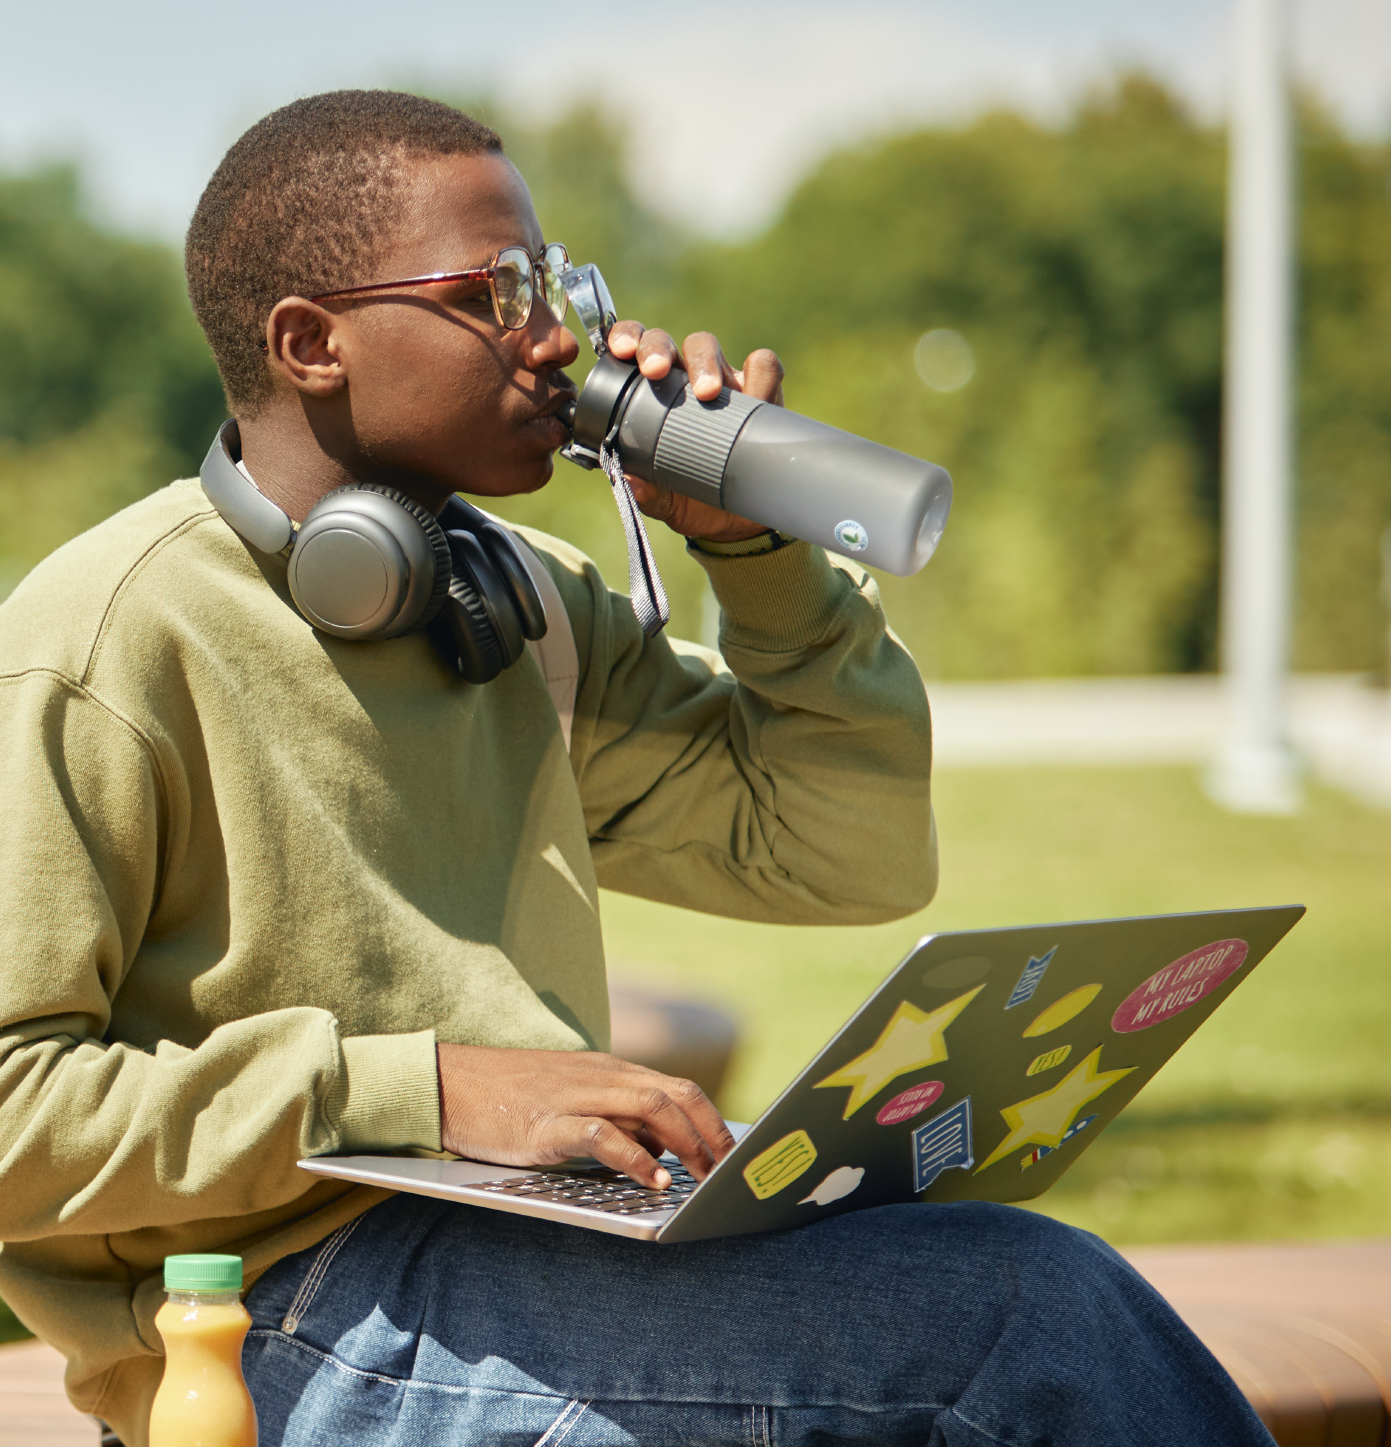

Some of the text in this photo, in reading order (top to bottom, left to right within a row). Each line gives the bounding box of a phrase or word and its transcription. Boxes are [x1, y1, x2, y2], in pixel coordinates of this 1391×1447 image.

[1011, 960, 1048, 1001] LOVE
[1143, 944, 1234, 998] MY LAPTOP
[1131, 977, 1209, 1025] MY RULES
[1032, 1046, 1068, 1074] YES!
[882, 1101, 928, 1122] MY LAPTOP
[919, 1085, 937, 1099] MY
[751, 1136, 813, 1194] YES!
[920, 1112, 963, 1177] LOVE
